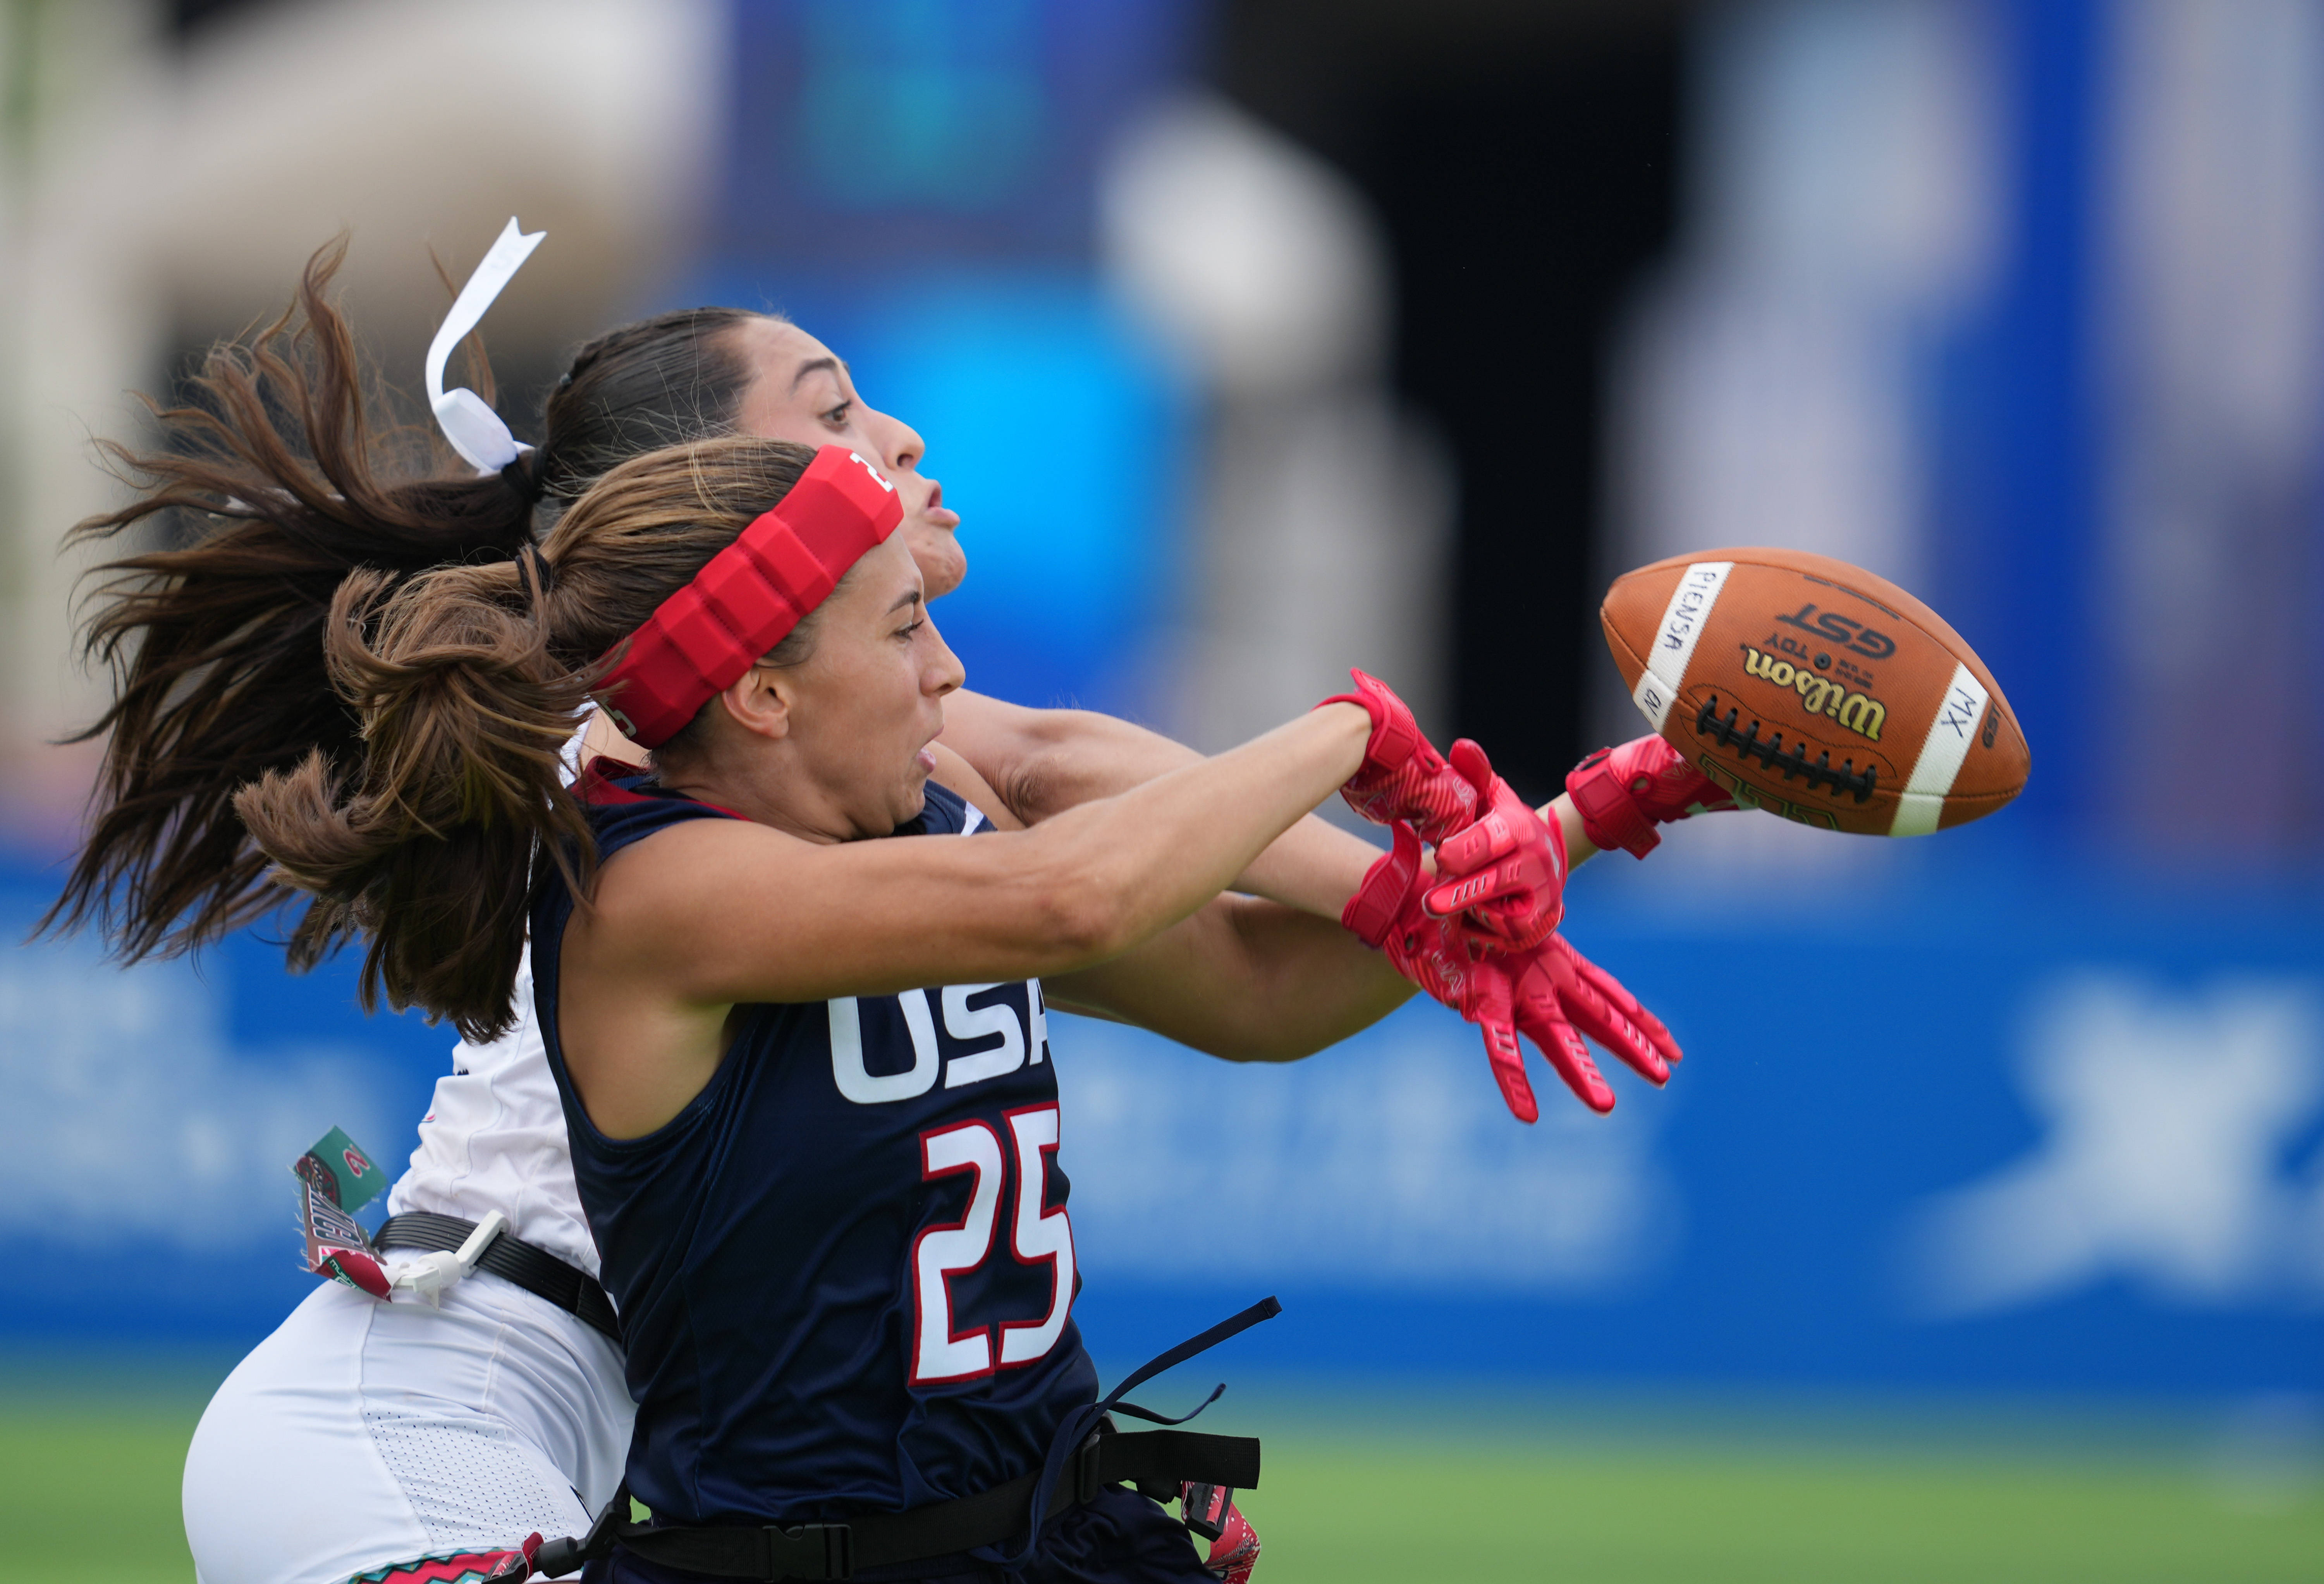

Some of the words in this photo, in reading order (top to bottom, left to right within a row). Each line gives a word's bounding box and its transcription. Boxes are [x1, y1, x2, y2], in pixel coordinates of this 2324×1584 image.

[1664, 570, 1716, 651] PIENSA
[1775, 601, 1896, 660] GST
[1744, 648, 1886, 742] Wilson
[1940, 686, 1978, 738] MX
[908, 1101, 1078, 1387] 25
